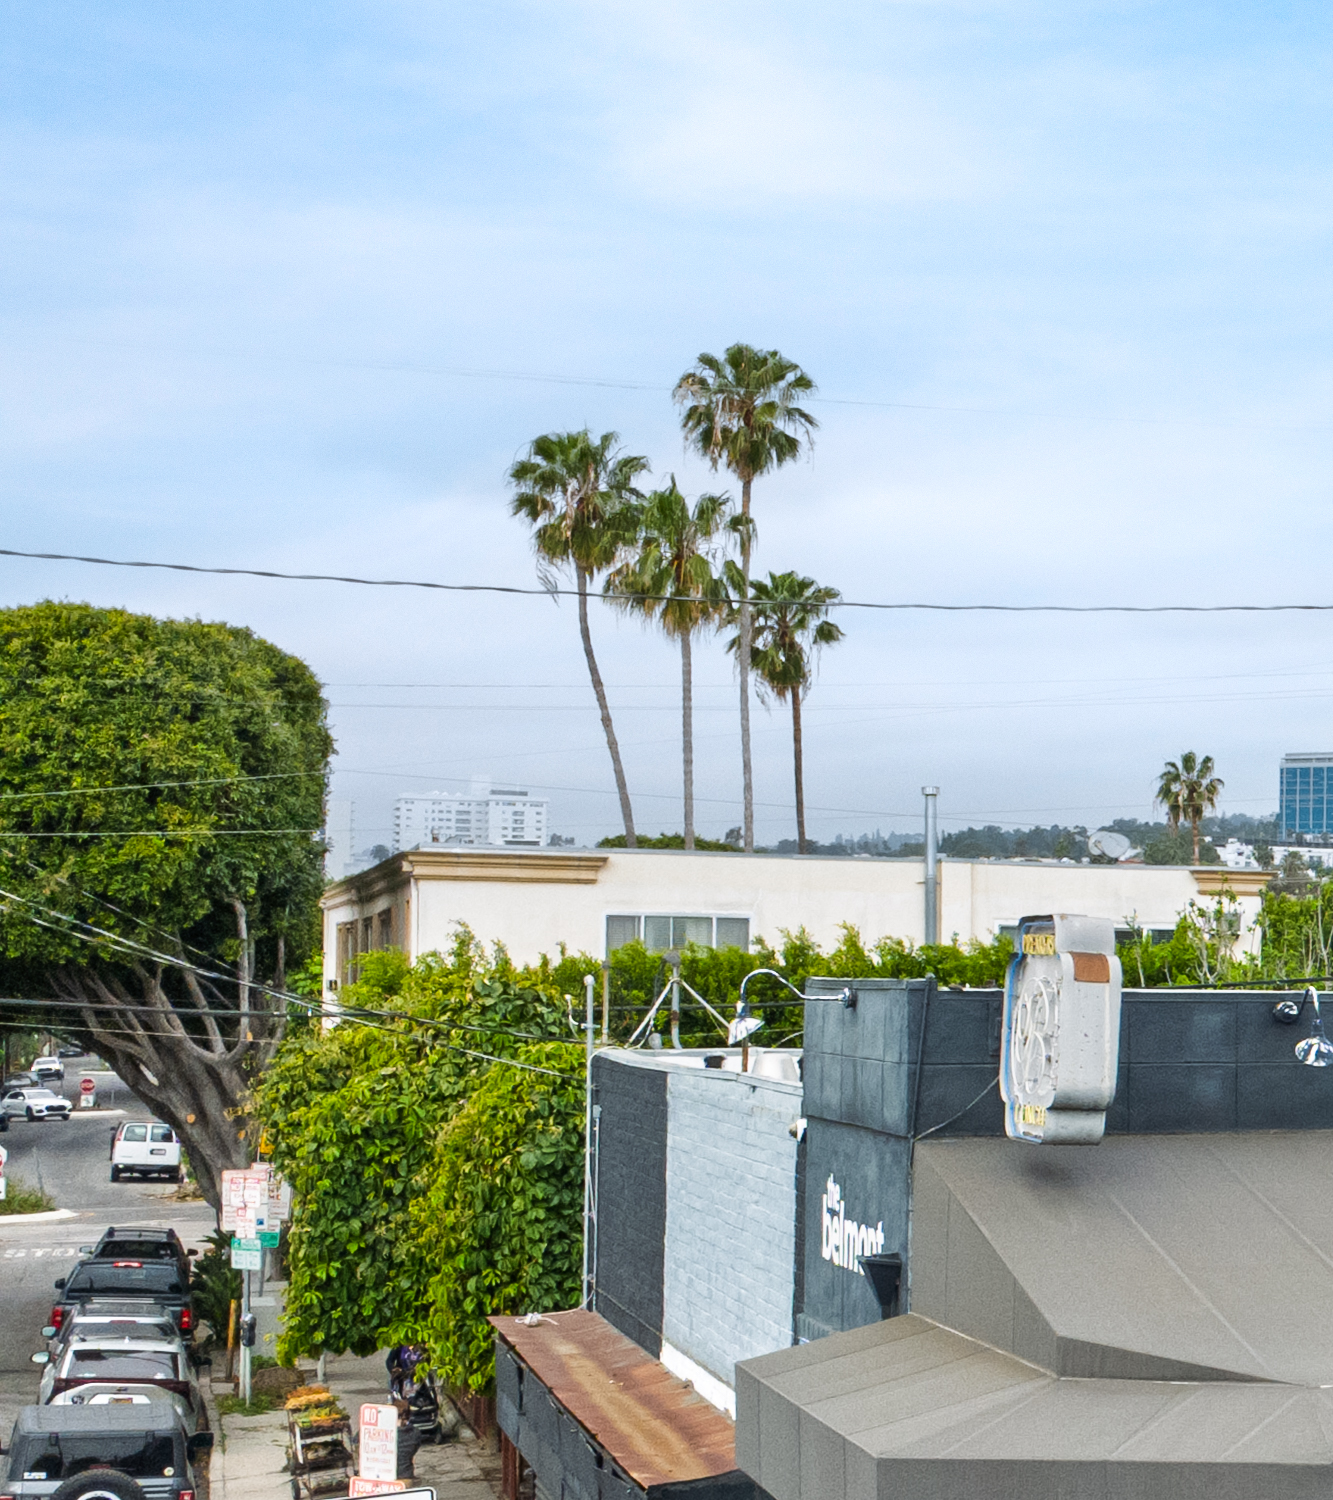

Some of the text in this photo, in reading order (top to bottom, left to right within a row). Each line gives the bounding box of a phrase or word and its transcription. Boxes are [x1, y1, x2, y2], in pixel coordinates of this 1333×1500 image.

[826, 1173, 841, 1212] the
[821, 1193, 885, 1276] belmont
[4, 1247, 84, 1259] STO
[364, 1408, 377, 1423] NO
[364, 1428, 394, 1443] PARKING
